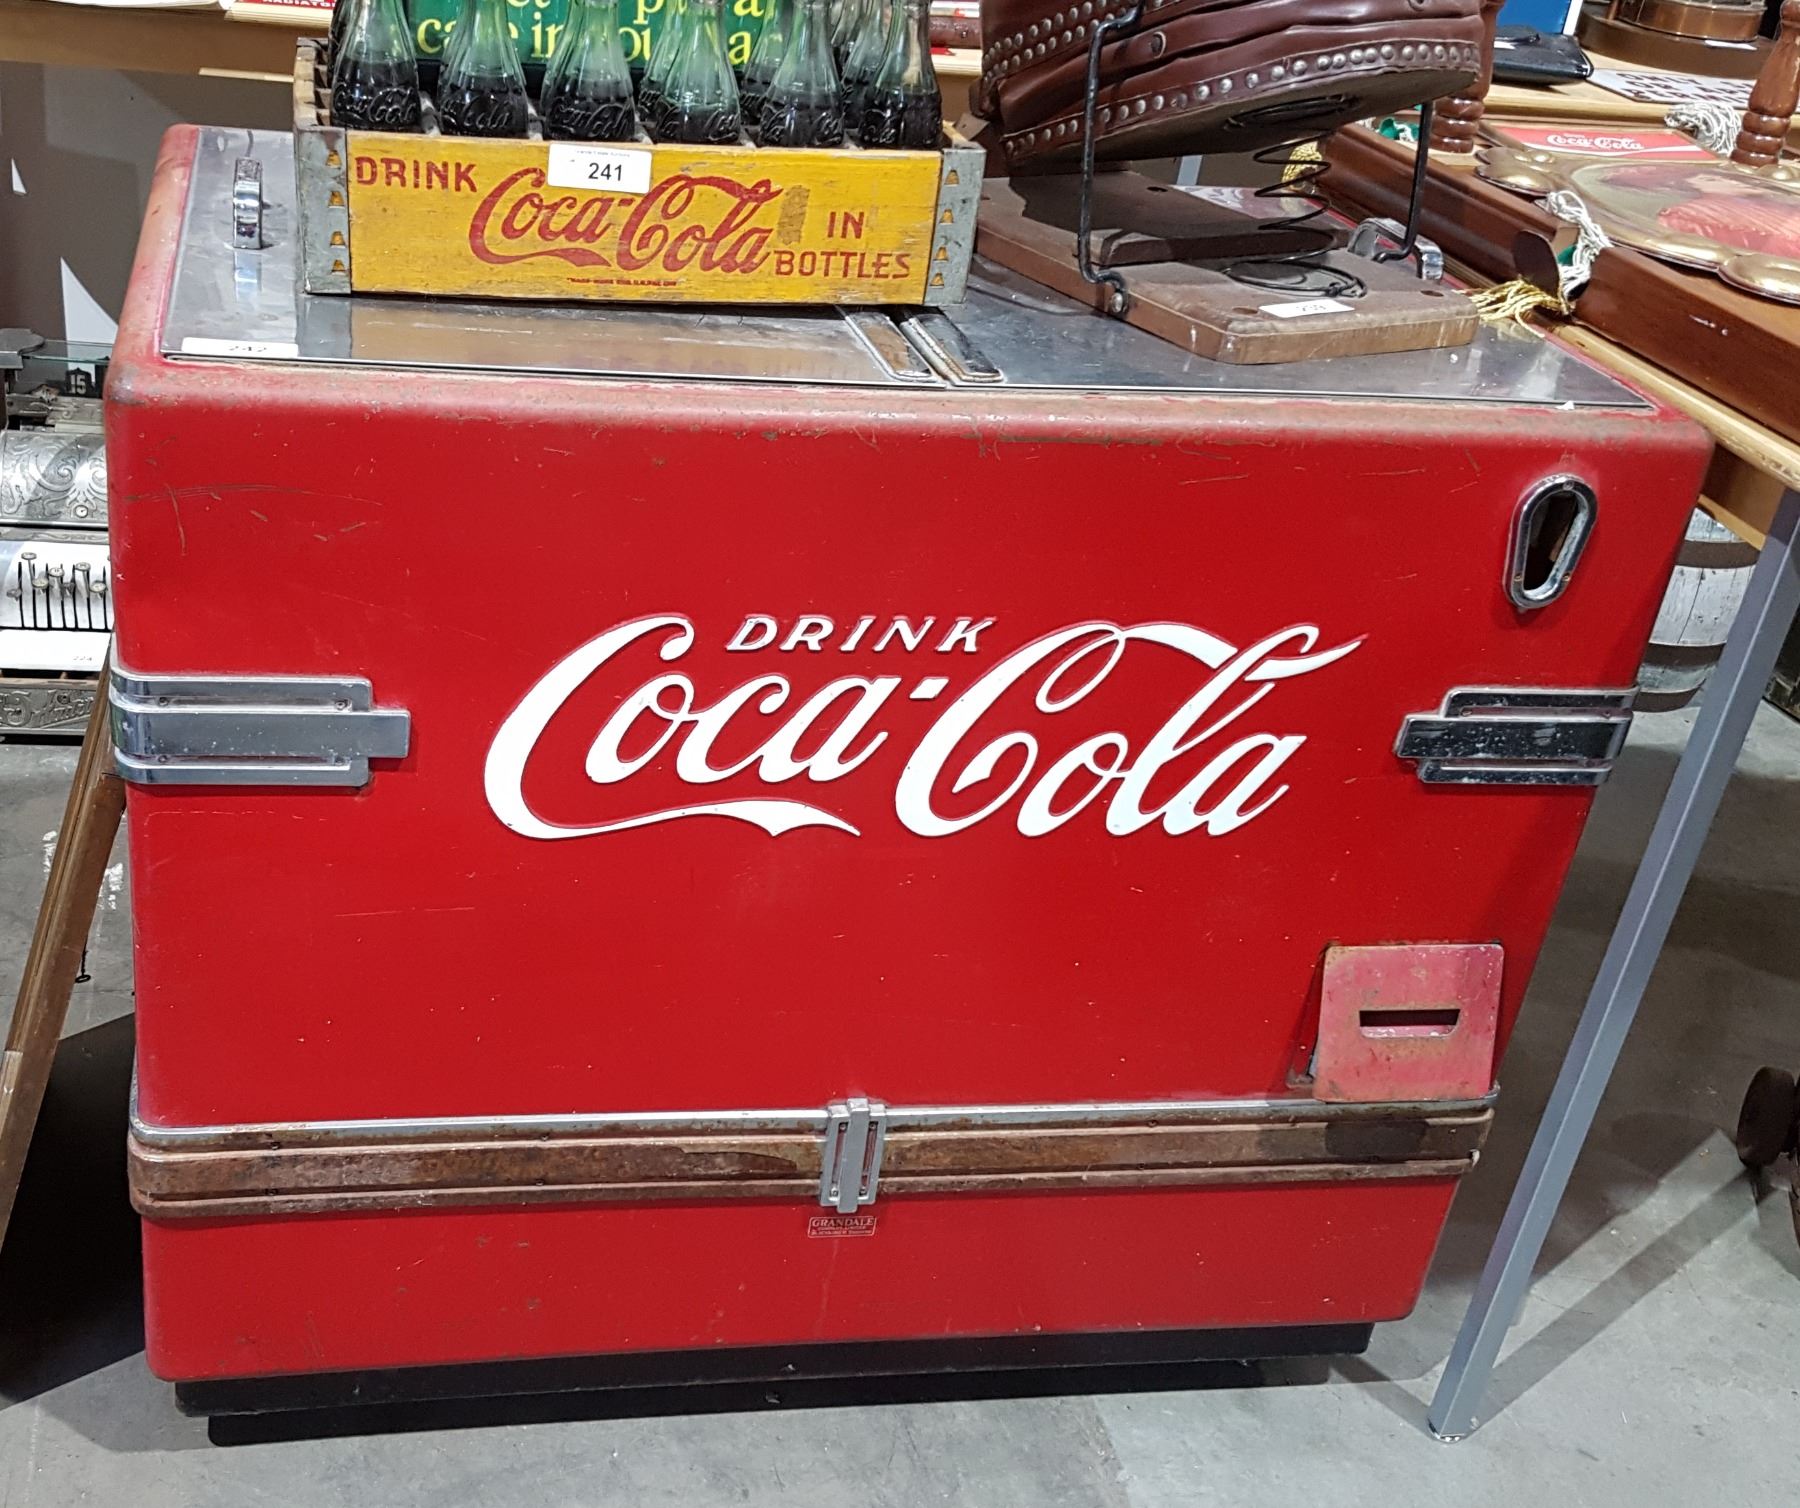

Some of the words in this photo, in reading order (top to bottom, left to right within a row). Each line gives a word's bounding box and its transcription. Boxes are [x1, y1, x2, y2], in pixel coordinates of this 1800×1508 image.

[356, 156, 477, 193] DRINK
[588, 162, 622, 182] 241
[468, 167, 784, 275] Coca-Cola
[827, 211, 864, 240] IN
[774, 250, 911, 279] BOTTLES
[69, 374, 87, 395] 15
[726, 614, 998, 653] DRINK
[484, 611, 1363, 840] Coca-Cola
[811, 1217, 875, 1227] GRANDALE
